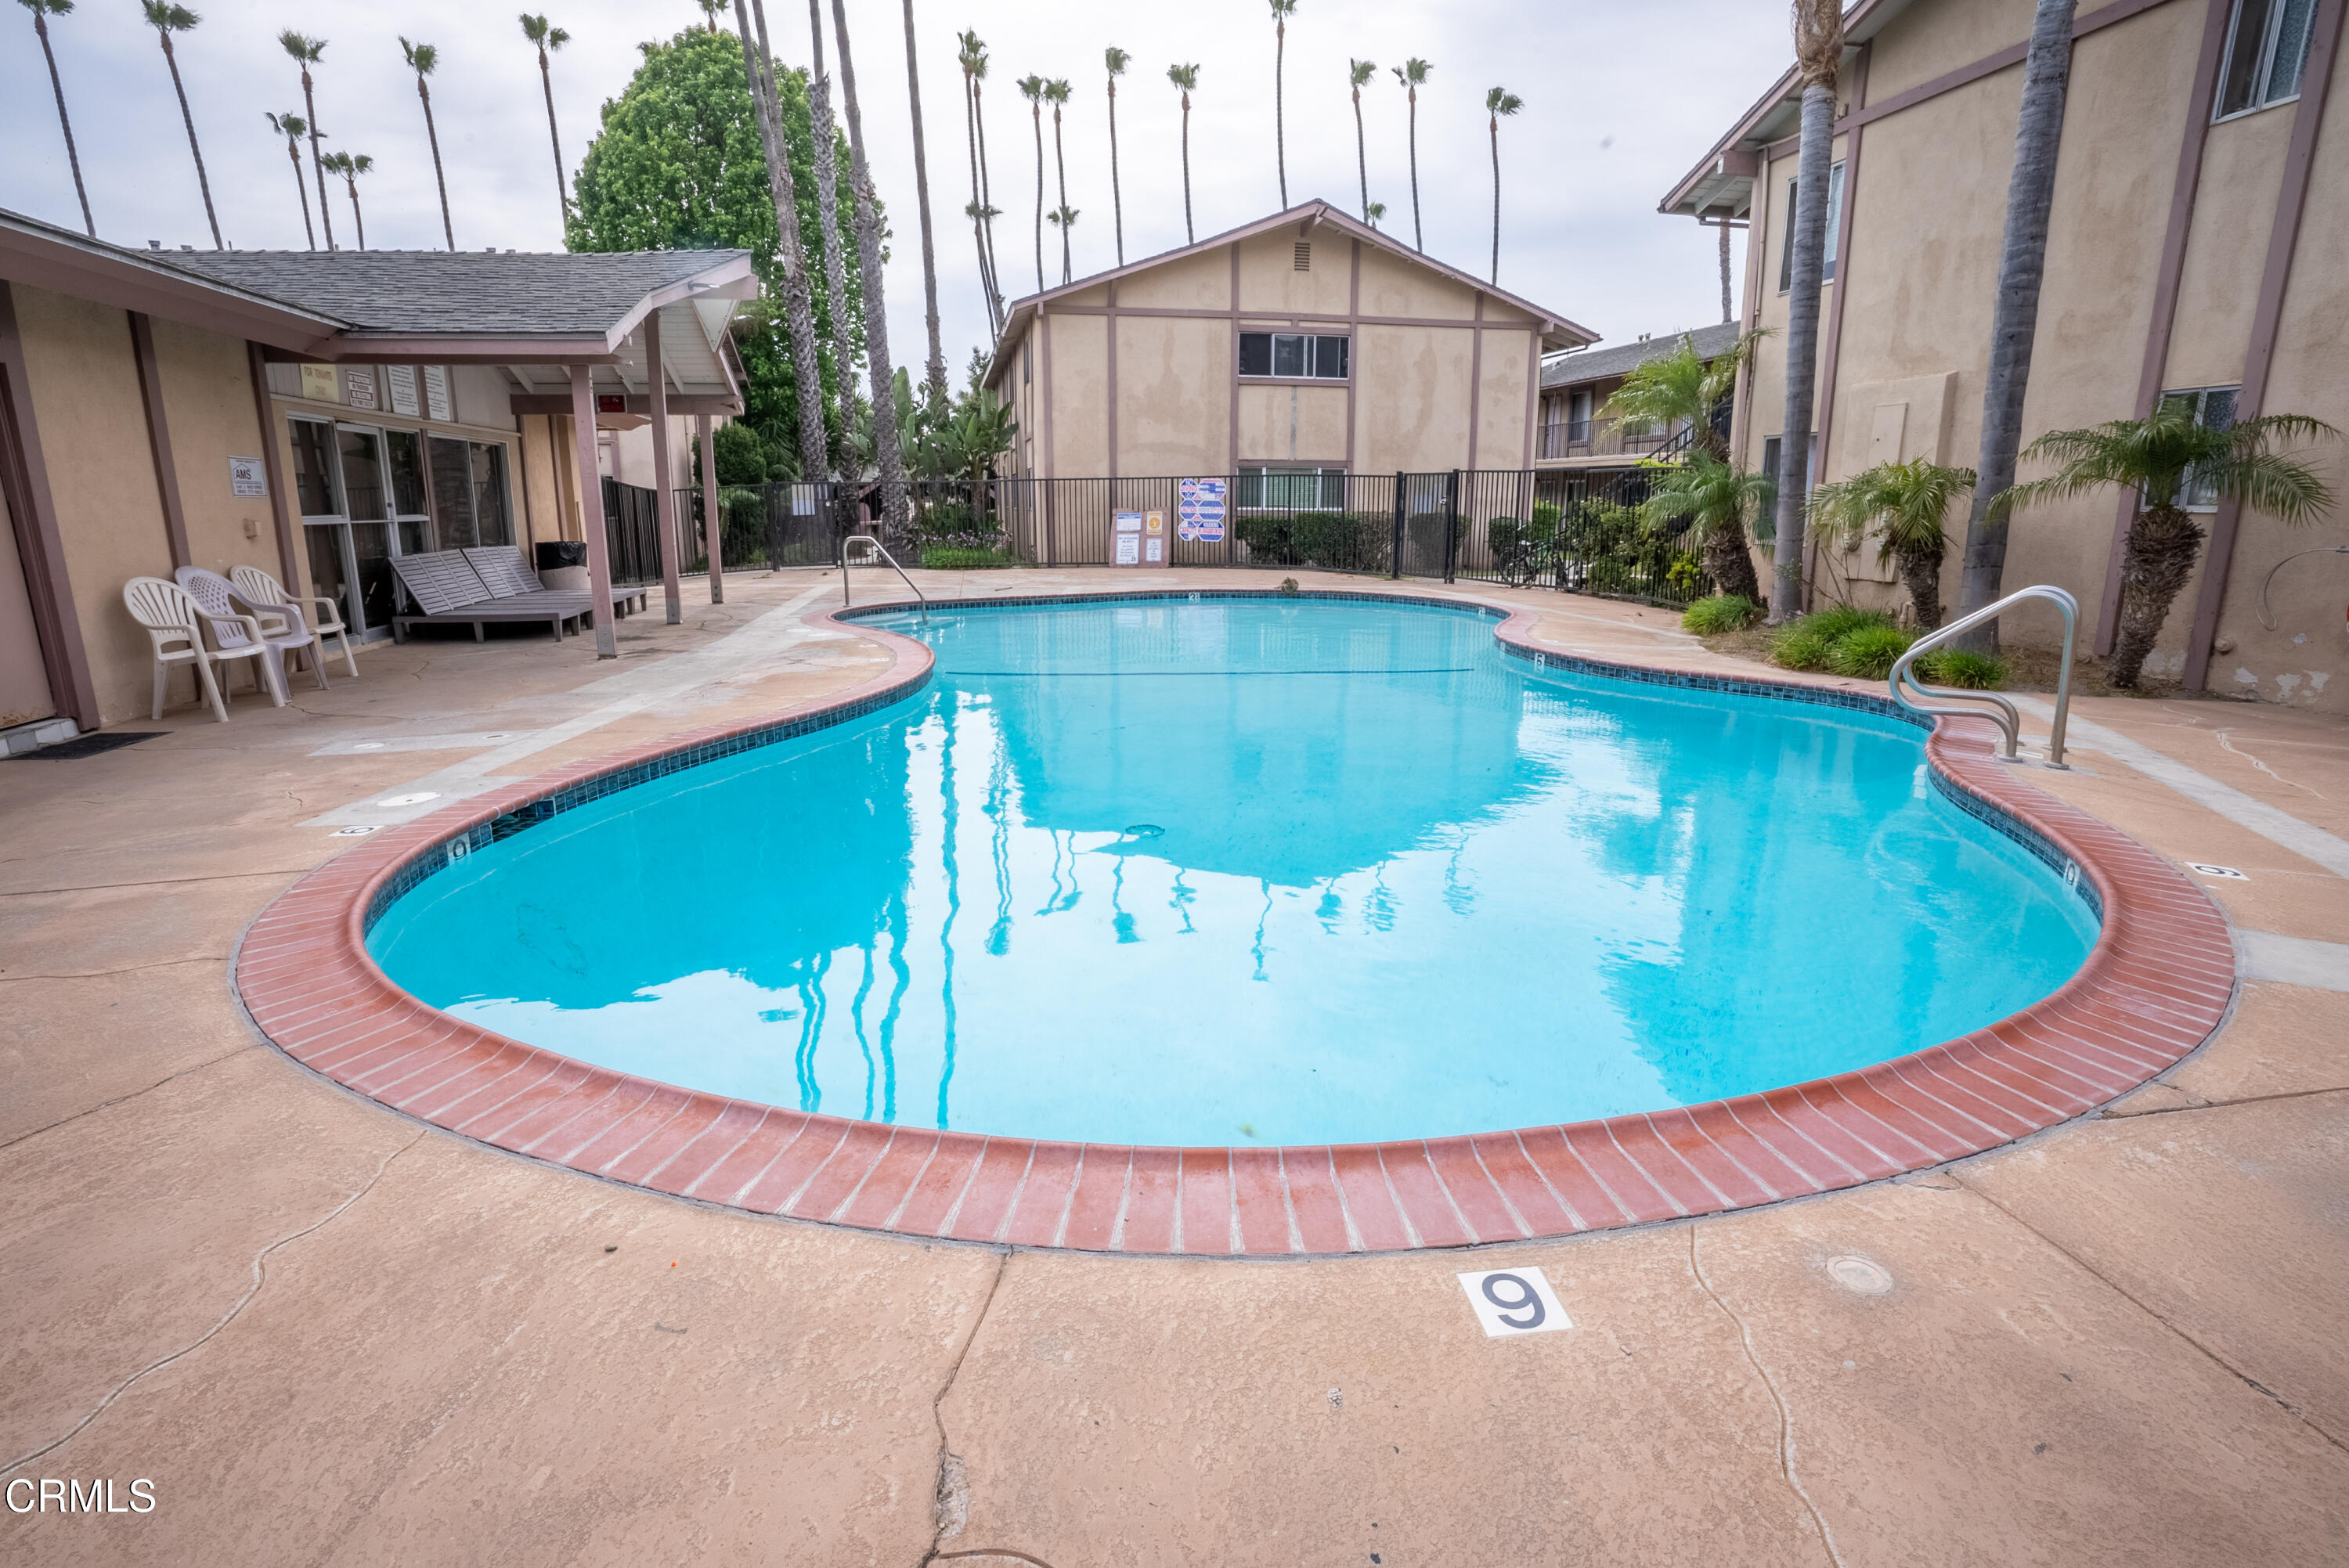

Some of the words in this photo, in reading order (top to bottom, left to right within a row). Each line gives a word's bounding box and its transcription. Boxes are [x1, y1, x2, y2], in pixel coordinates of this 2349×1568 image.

[304, 366, 313, 377] FOR
[315, 368, 333, 382] TENANTS
[236, 469, 251, 480] AMS
[1481, 1273, 1546, 1329] 9
